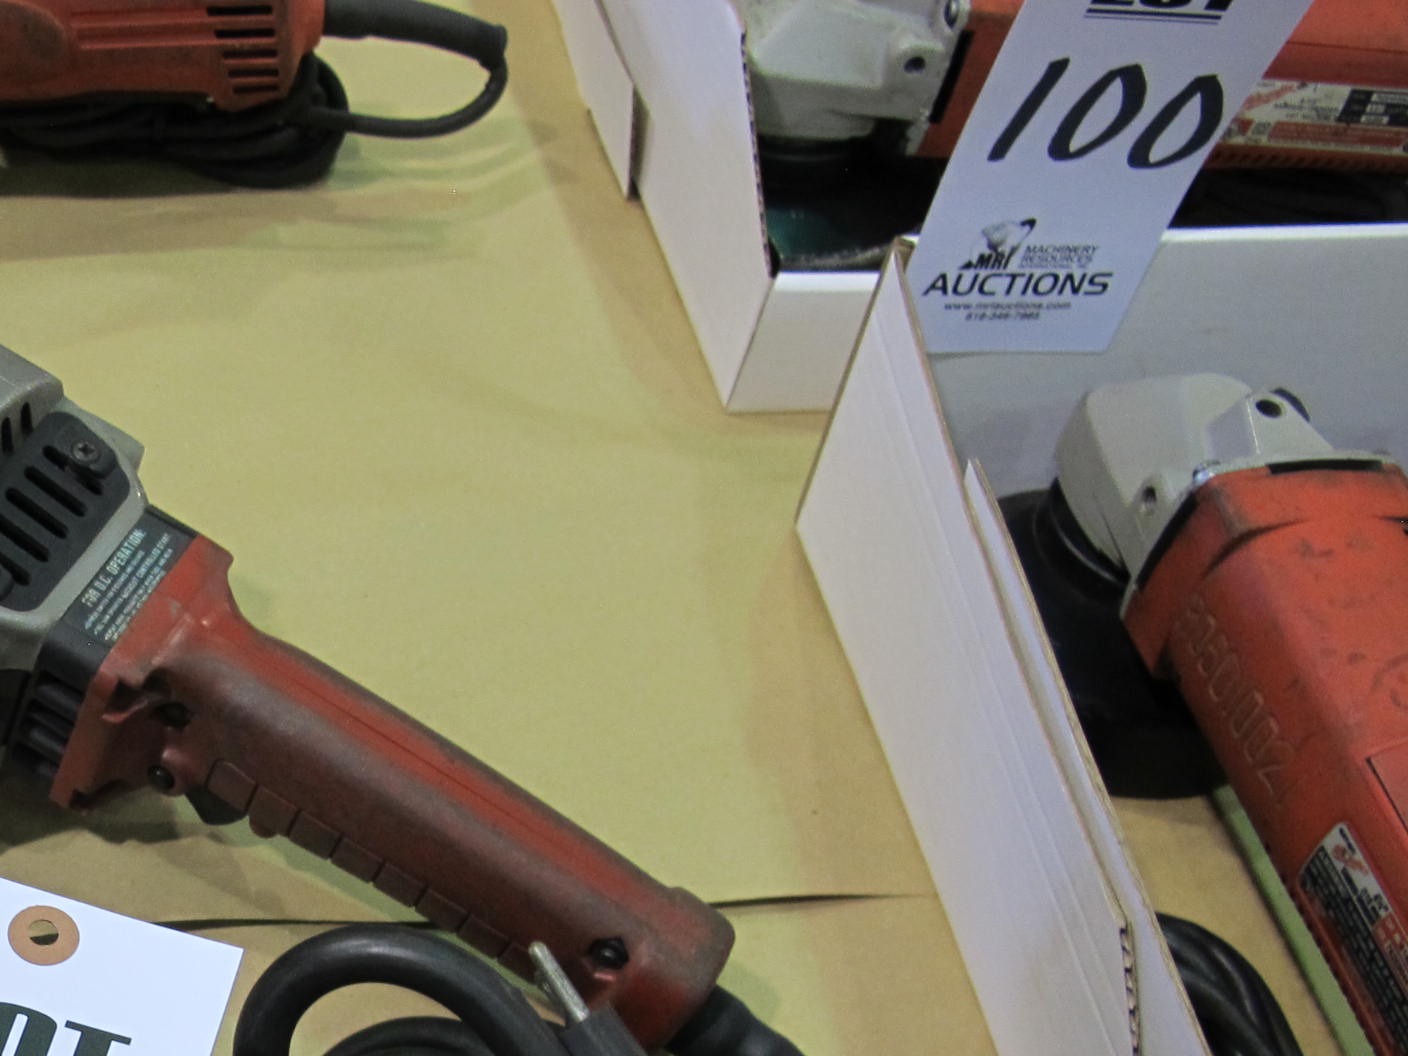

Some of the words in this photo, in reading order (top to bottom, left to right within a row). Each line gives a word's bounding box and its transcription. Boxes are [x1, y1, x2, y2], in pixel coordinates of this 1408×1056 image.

[987, 56, 1224, 169] 100
[974, 249, 1016, 271] MRI
[922, 272, 1113, 297] AUCTIONS
[81, 589, 100, 607] FOR
